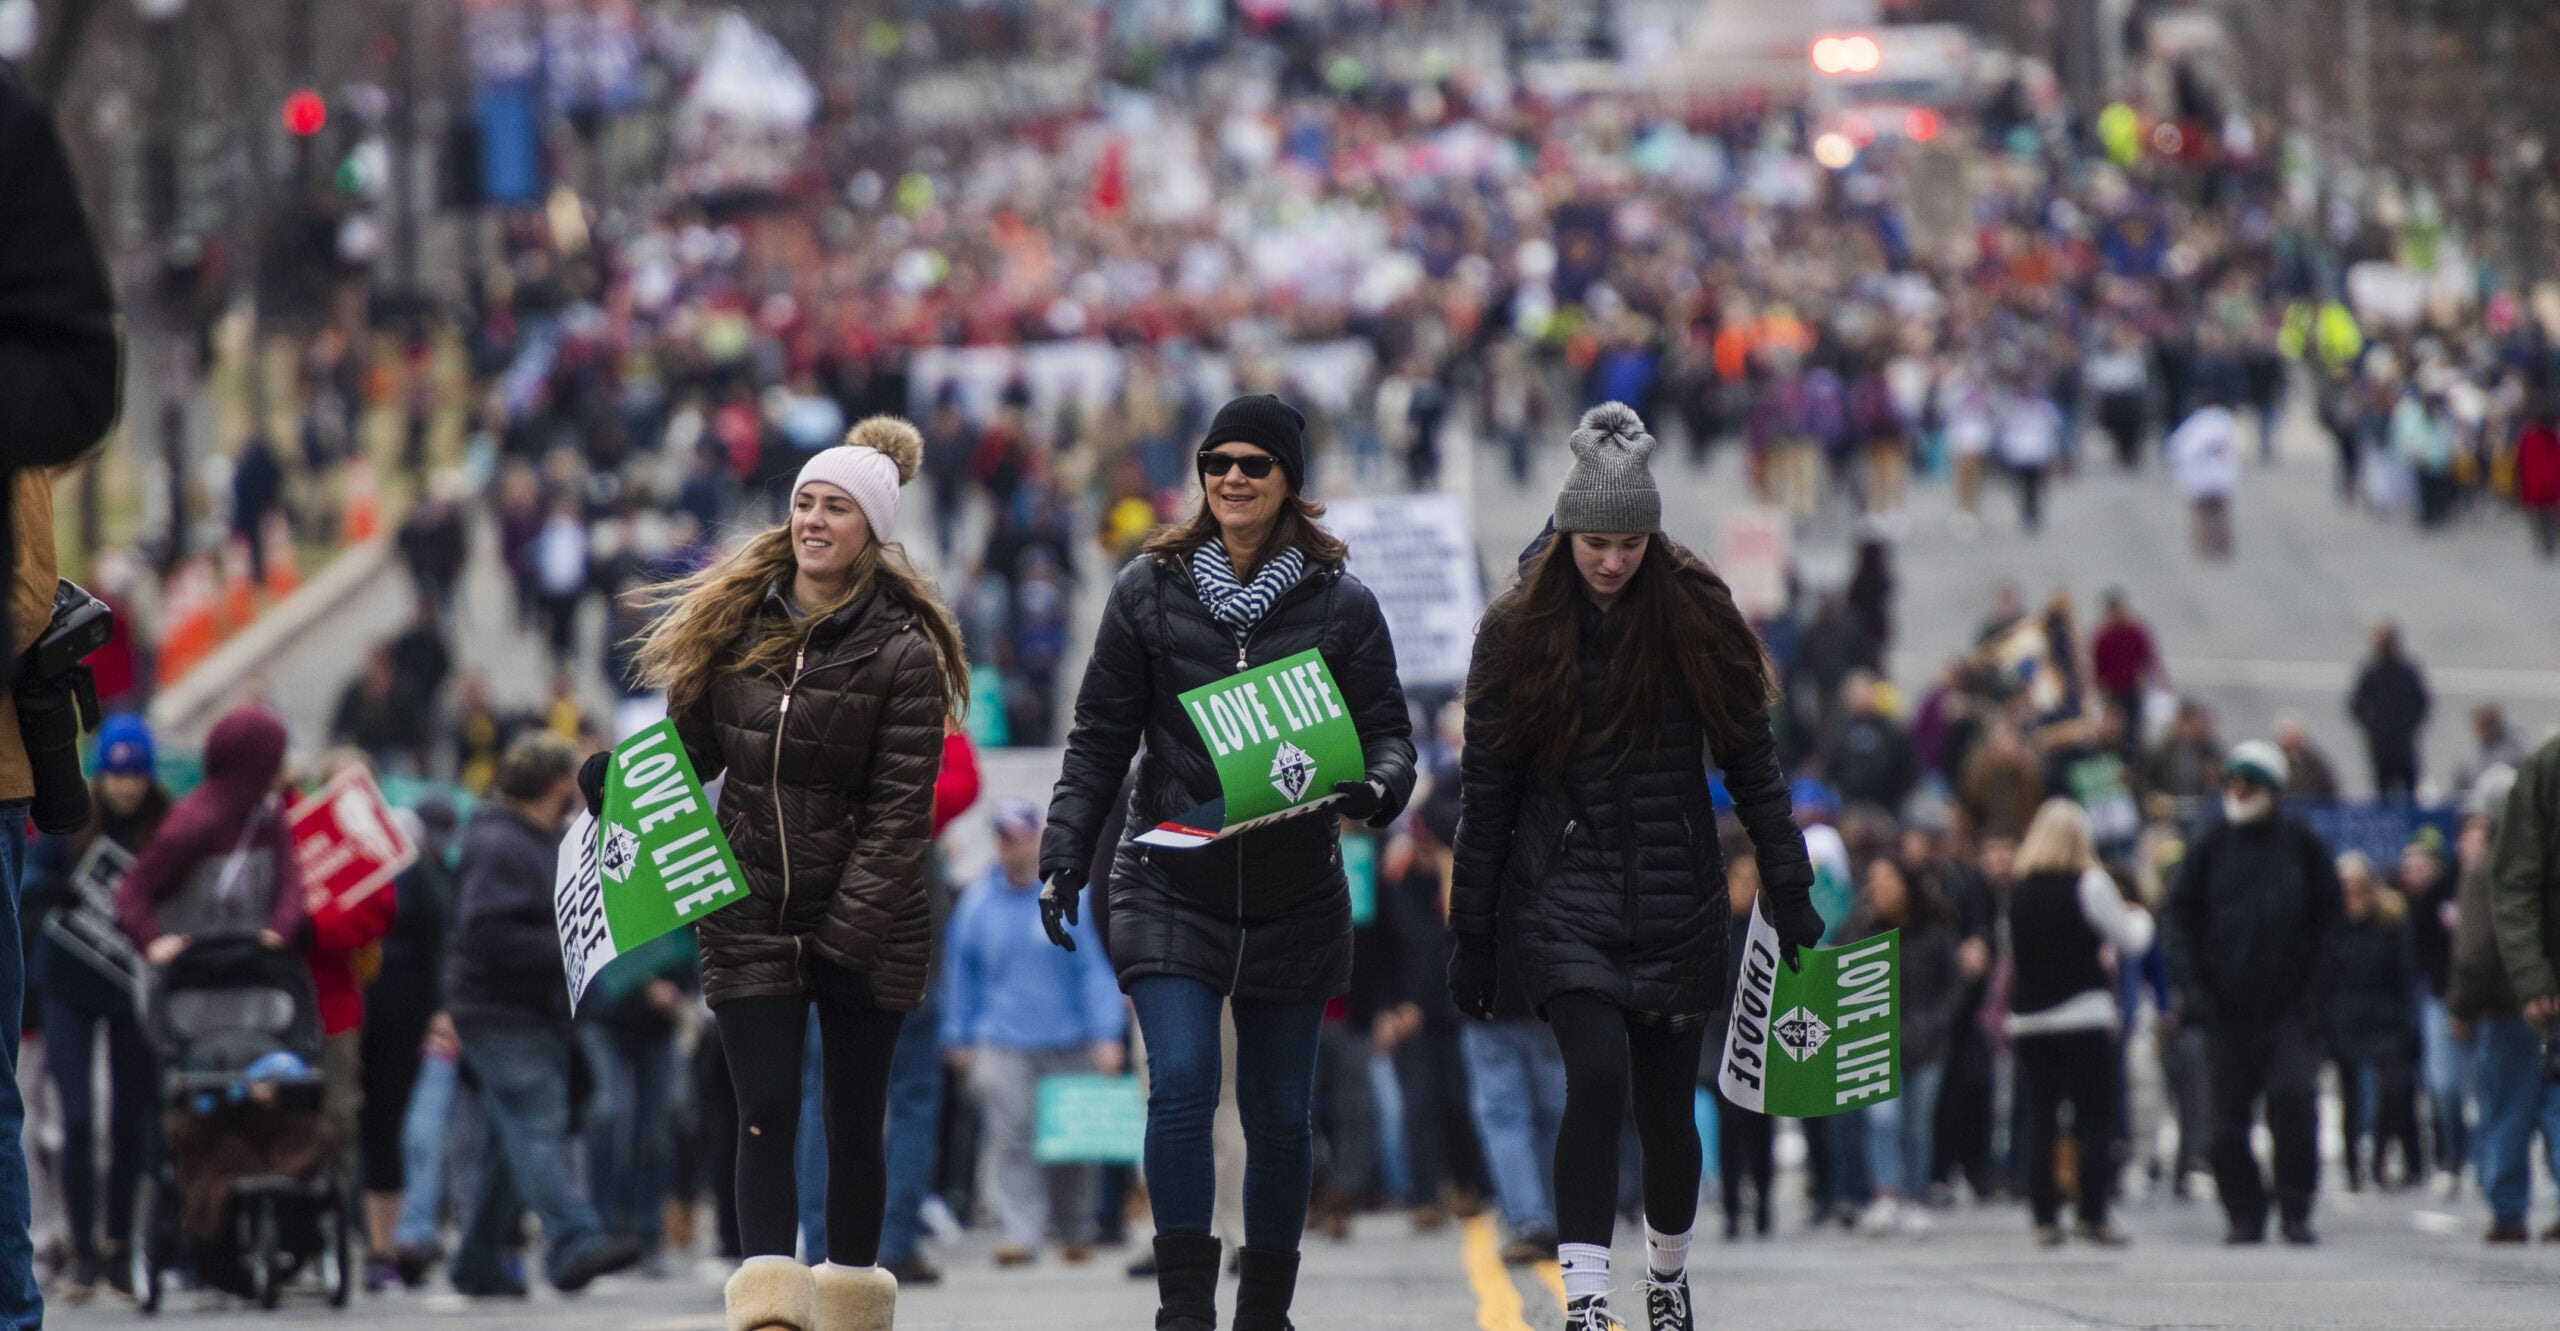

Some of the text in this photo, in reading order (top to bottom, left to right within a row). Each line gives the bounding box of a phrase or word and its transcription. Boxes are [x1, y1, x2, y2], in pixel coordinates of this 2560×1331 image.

[1191, 660, 1342, 757] LOVE LIFE
[1279, 758, 1286, 768] K
[1295, 752, 1301, 762] C
[618, 731, 736, 916] LOVE LIFE
[624, 853, 632, 863] C
[558, 873, 579, 956] LIFE
[1727, 939, 1775, 1091] CHOOSE
[1836, 941, 1890, 1106] LOVE LIFE
